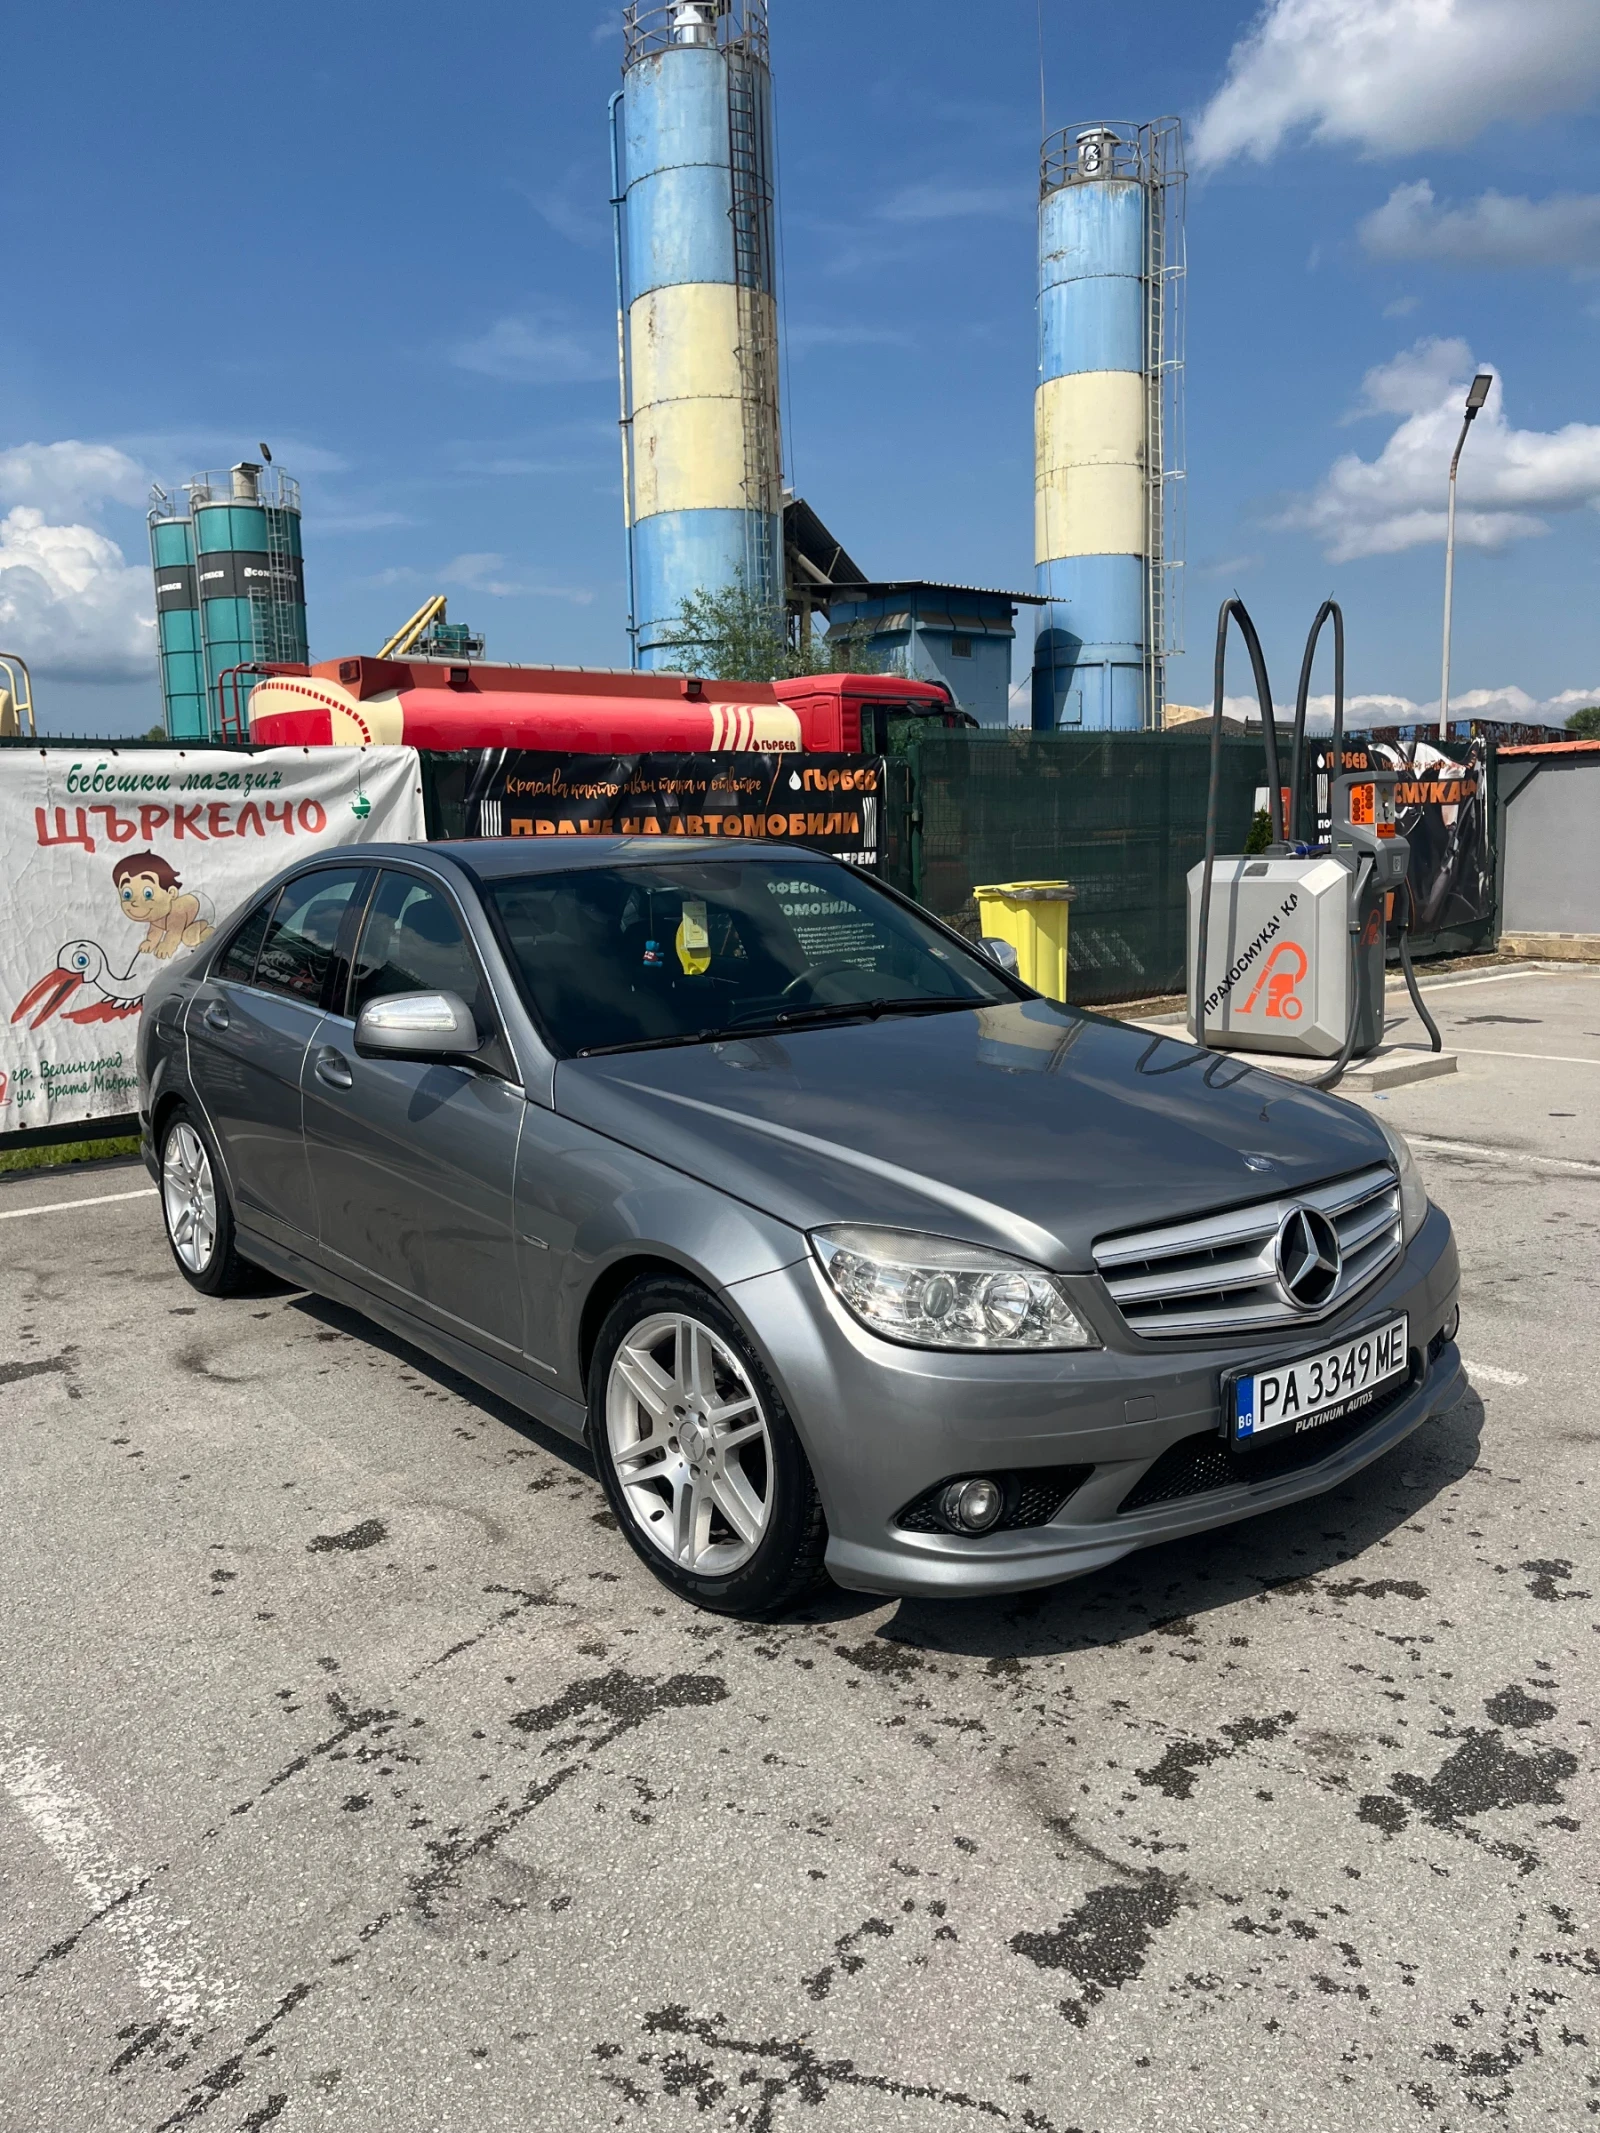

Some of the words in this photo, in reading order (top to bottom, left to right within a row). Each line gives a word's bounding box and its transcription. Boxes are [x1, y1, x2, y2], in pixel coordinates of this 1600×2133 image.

[761, 739, 797, 751] ГЪРБЕВ
[66, 764, 171, 794] бебешки
[180, 771, 282, 797] магазин
[802, 769, 877, 791] ГЪРБЕВ
[35, 798, 326, 853] ЩЪРКЕЛЧО
[667, 812, 859, 837] АВТОМОБИЛИ
[1203, 893, 1298, 1016] ПРАХОСМУКАКА
[93, 1073, 139, 1095] Маврик
[1259, 1370, 1300, 1423] PA
[1306, 1341, 1371, 1405] 3349
[1374, 1322, 1404, 1377] ME
[1238, 1412, 1253, 1429] BG
[1295, 1405, 1344, 1434] PLATINUM
